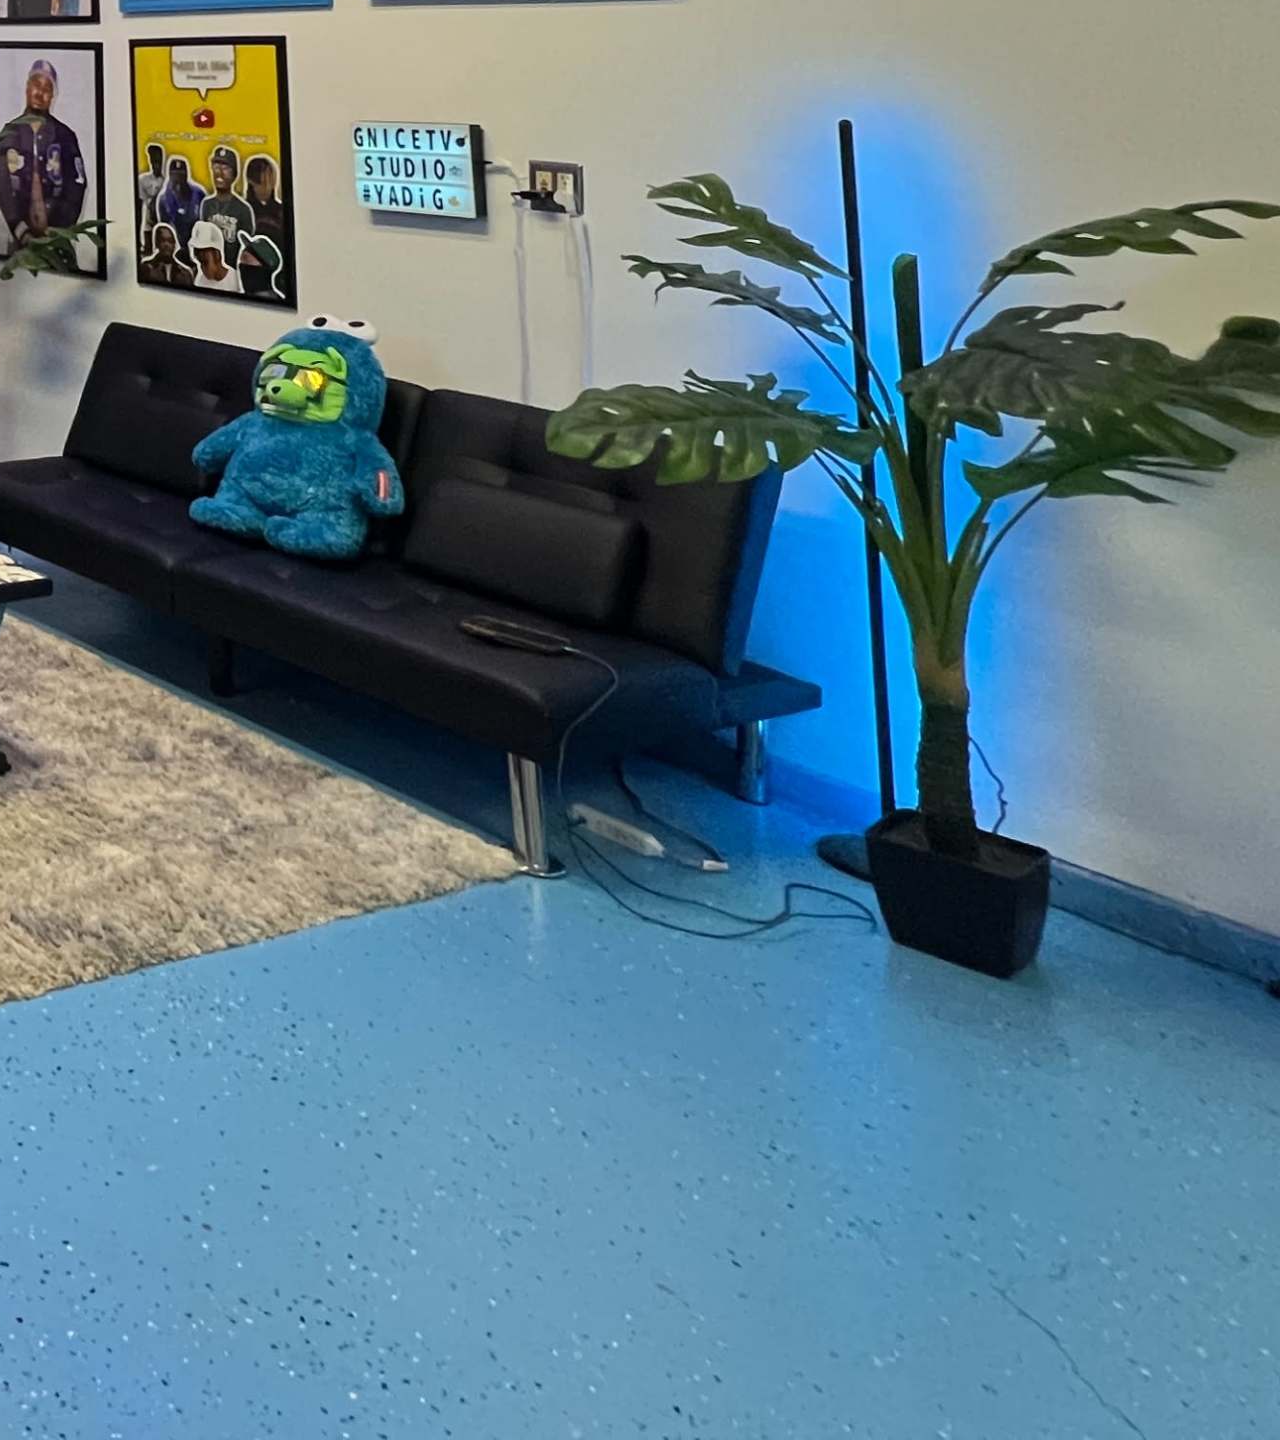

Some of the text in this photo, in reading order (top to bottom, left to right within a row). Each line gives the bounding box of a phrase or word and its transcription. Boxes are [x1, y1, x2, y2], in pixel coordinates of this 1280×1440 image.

[354, 127, 451, 151] GNICETV
[364, 155, 445, 180] STUDIO
[363, 184, 444, 210] #YADiG
